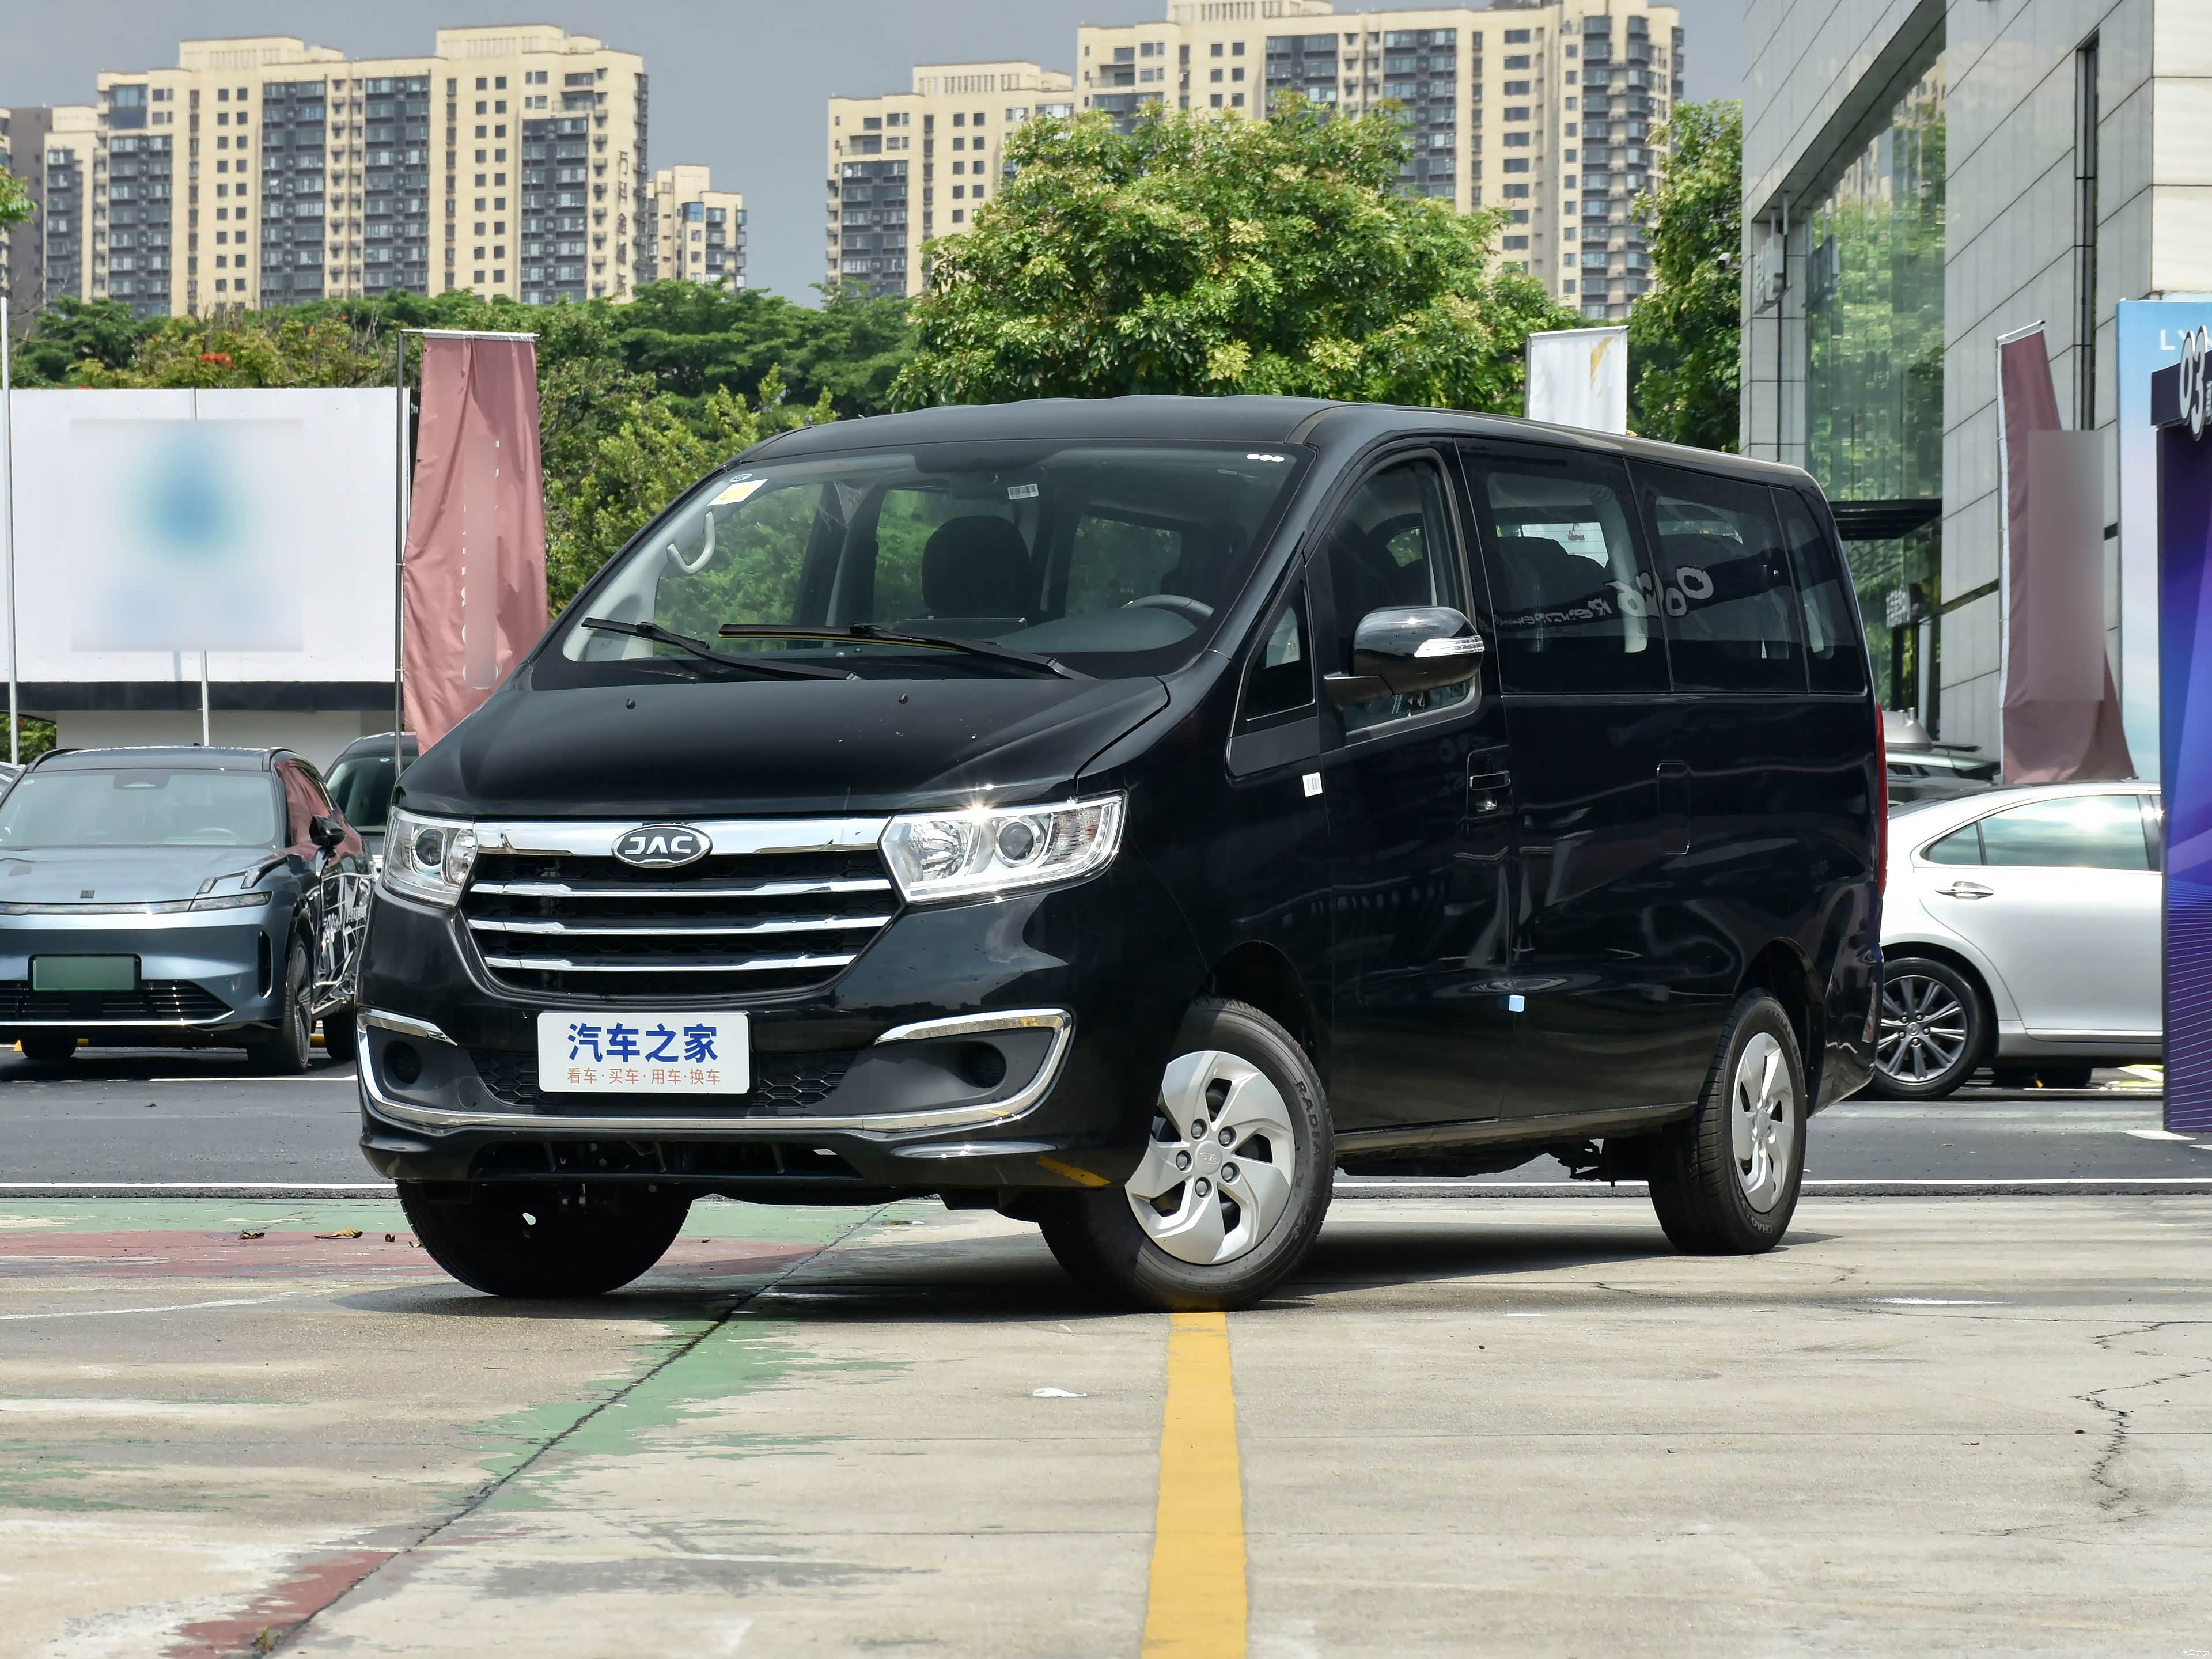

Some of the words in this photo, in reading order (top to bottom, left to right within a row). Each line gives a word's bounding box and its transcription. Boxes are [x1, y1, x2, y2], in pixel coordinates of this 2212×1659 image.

[2180, 326, 2205, 435] 03
[625, 836, 693, 854] JAC
[567, 1022, 718, 1063] 汽车之家
